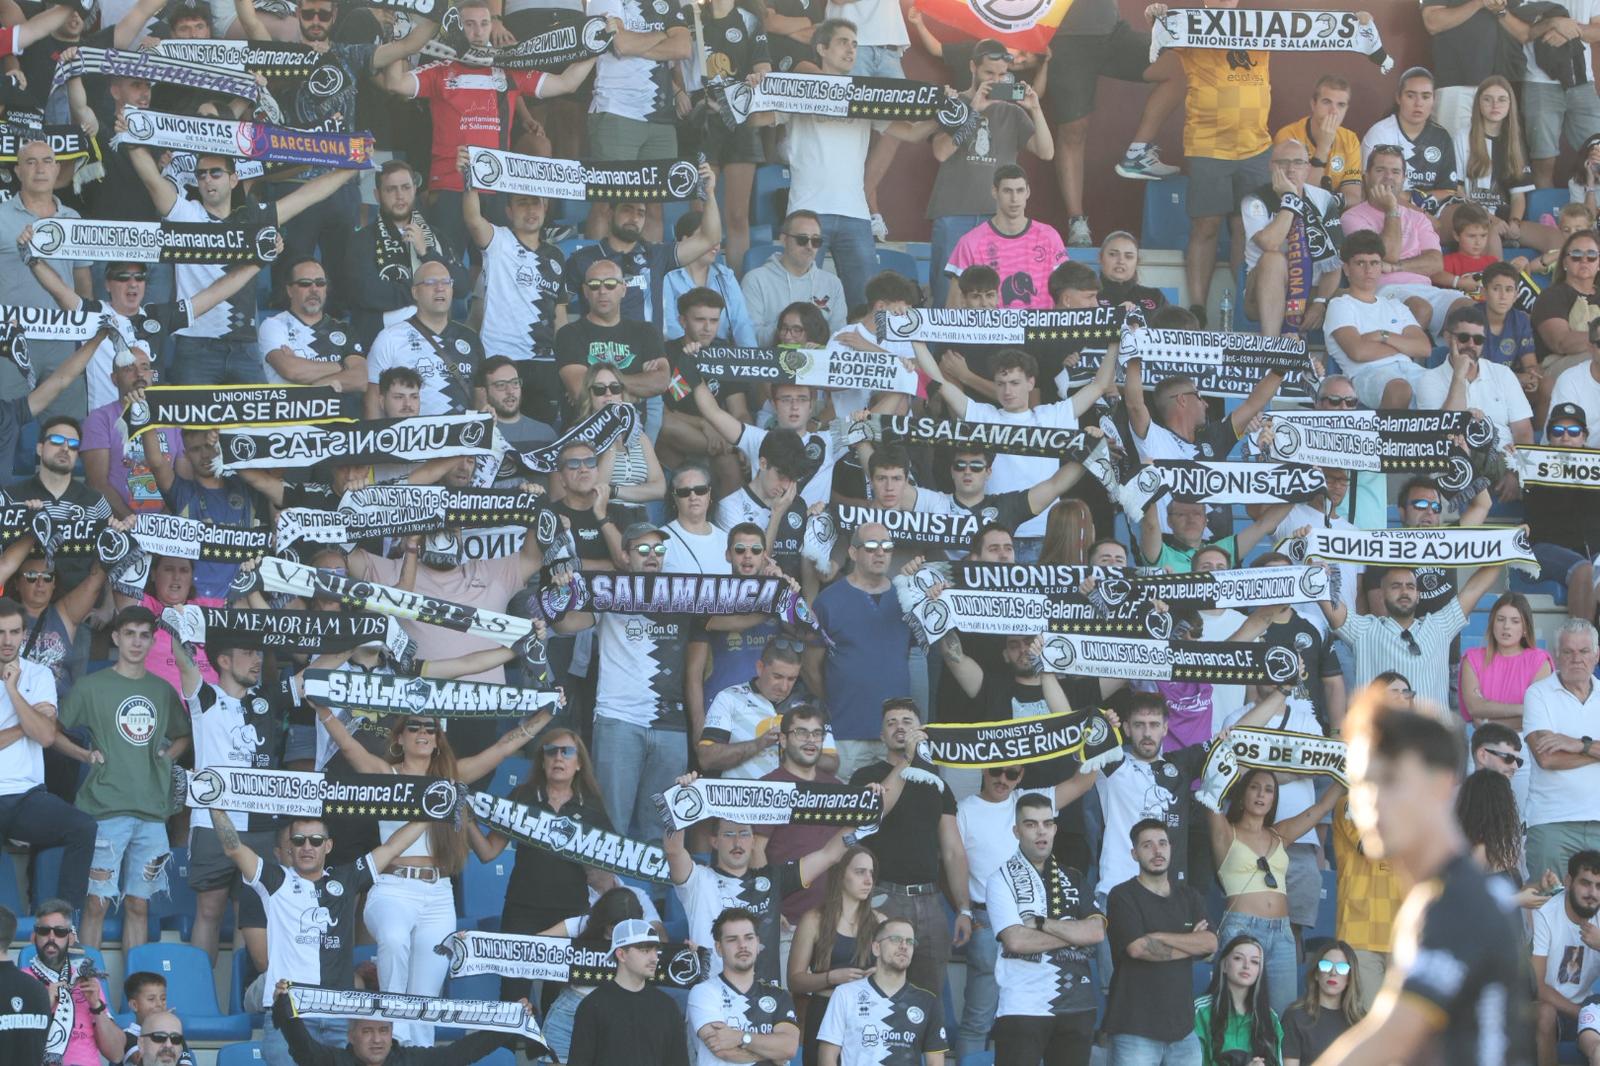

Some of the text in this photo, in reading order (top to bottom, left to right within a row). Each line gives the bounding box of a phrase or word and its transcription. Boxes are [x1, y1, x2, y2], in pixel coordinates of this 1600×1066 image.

[1187, 35, 1353, 48] UNIONISTAS DE SALAMANCA
[161, 42, 302, 67] UNIONISTAS de Salamanca
[761, 76, 938, 105] UNIONISTAS de Salamanca C.F.
[156, 116, 233, 139] UNIONISTAS
[271, 134, 346, 156] BARCELONA
[505, 156, 661, 186] UNIONISTAS de Salamanca C.F.
[71, 224, 249, 249] UNIONISTAS de Salamanca C.F.
[927, 307, 1117, 328] UNIONISTAS de Salamanca C.F.
[589, 341, 630, 356] GREMLINS
[829, 351, 898, 365] AGAINST
[459, 363, 472, 373] QR
[730, 364, 779, 378] VASCO
[829, 362, 897, 379] MODERN
[828, 375, 895, 390] FOOTBALL
[213, 390, 287, 402] UNIONISTAS
[158, 399, 341, 423] NUNCA SE RINDE
[891, 414, 1085, 451] U.SALAMANCA
[1372, 415, 1439, 433] Salamanca
[1441, 412, 1462, 431] C.F.
[1304, 428, 1434, 457] UNIONISTAS de Salamanca
[1161, 468, 1326, 496] UNIONISTAS
[352, 487, 538, 511] UNIONISTAS de Salamanca C.F.
[74, 519, 97, 541] C.F.
[181, 519, 267, 549] de Salamanca
[840, 522, 851, 530] DE
[916, 534, 940, 543] CLUB
[944, 535, 956, 544] DE
[785, 538, 798, 549] QR
[591, 574, 780, 614] SALAMANCA
[1159, 582, 1220, 603] Salamanca
[1221, 582, 1236, 601] de
[1236, 576, 1296, 601] UNIONISTAS
[952, 594, 1140, 620] UNIONISTAS de C.F.
[349, 616, 386, 635] VDS
[646, 623, 679, 635] Don QR
[263, 635, 287, 647] 1923
[1081, 640, 1259, 668] UNIONISTAS de Salamanca C.F.
[328, 671, 540, 712] SALAMANCA
[977, 722, 1044, 741] UNIONISTAS
[929, 740, 1004, 762] NUNCA
[1005, 737, 1031, 759] SE
[1268, 746, 1293, 762] DE
[230, 772, 415, 803] UNIONISTAS de Salamanca C.F.
[705, 784, 879, 810] UNIONISTAS de Salamanca C.F.
[471, 936, 565, 964] UNIONISTAS de
[882, 1030, 901, 1041] Don
